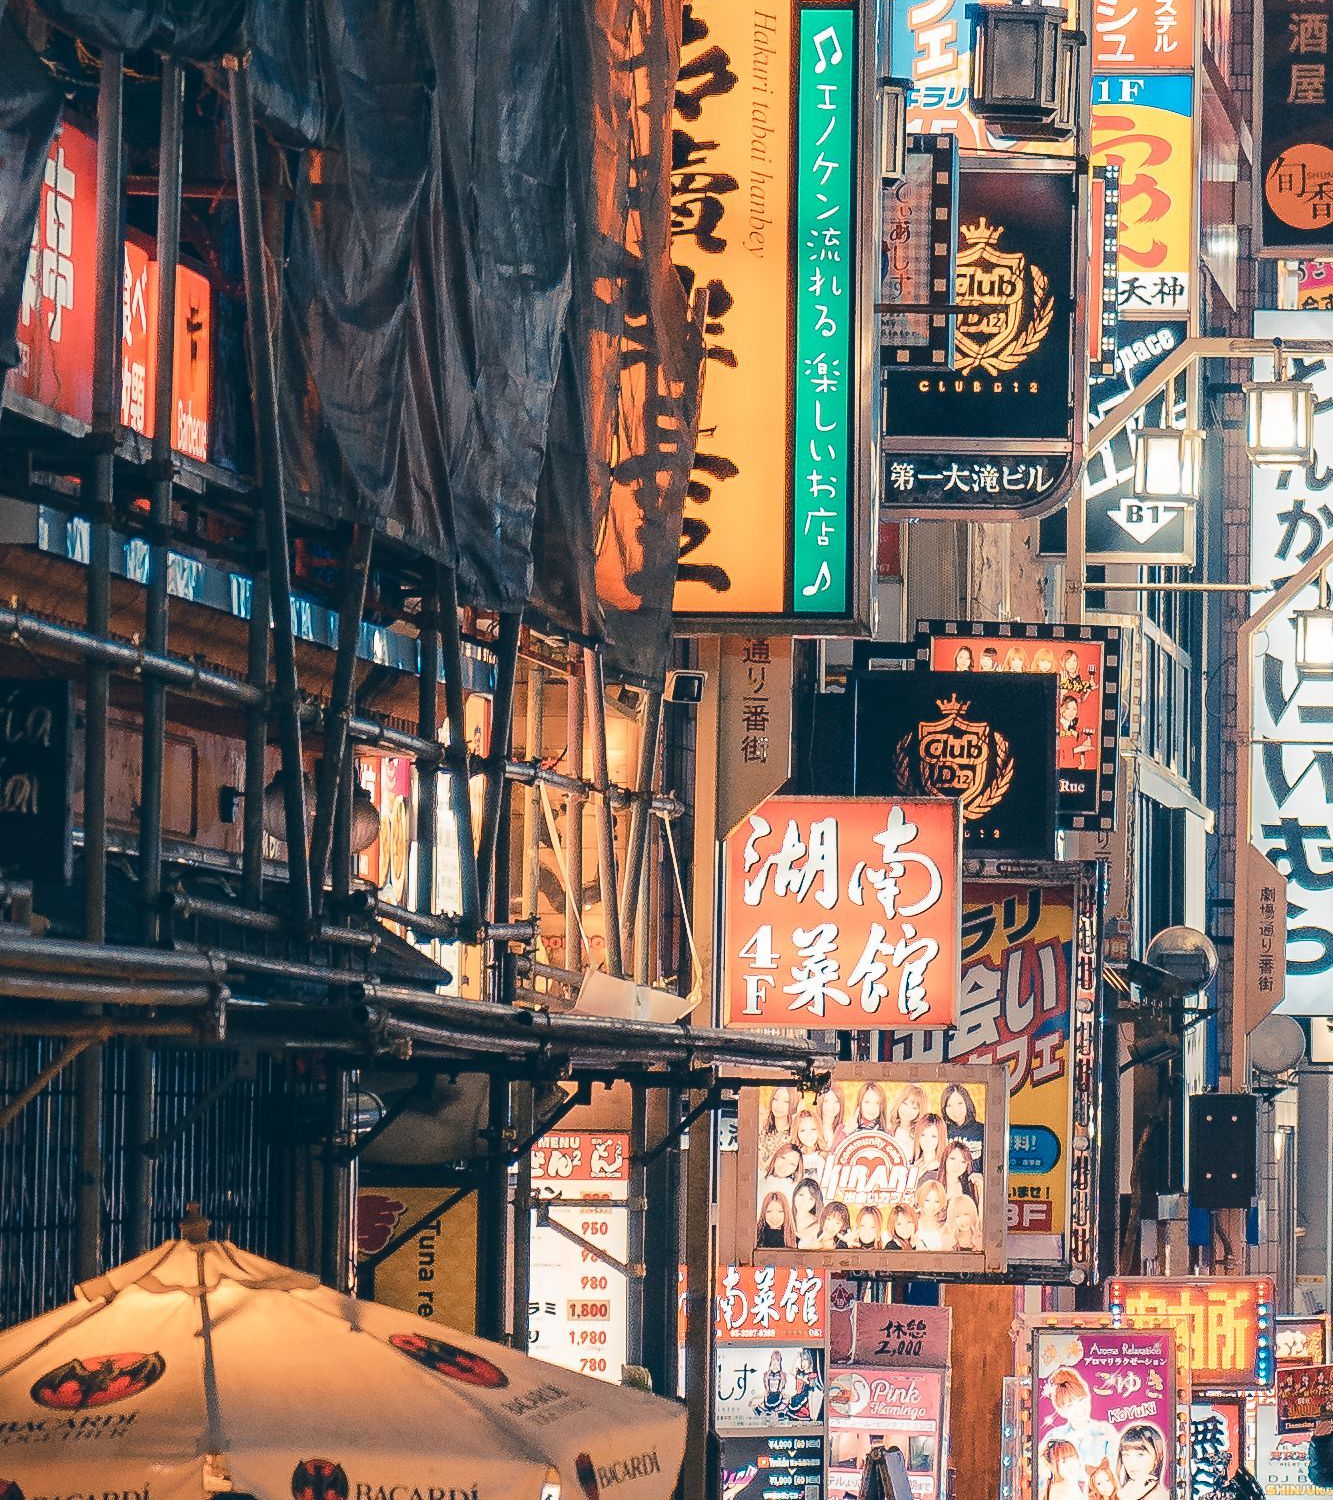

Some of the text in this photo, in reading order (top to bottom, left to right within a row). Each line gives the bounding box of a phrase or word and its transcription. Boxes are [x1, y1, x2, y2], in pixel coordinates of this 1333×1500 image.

[1097, 78, 1146, 102] 1F
[740, 9, 777, 260] Hakuri tabai hanbey
[803, 82, 842, 547] エノケン流れる 楽しいお店
[919, 380, 982, 394] CLUB
[889, 462, 1055, 494] 第一大滝ビル
[923, 735, 984, 762] Club
[744, 803, 944, 922] 湖南
[782, 921, 941, 1023] 菜館
[581, 1221, 608, 1236] 950
[569, 1303, 609, 1319] 1,800
[569, 1331, 608, 1347] 1,980
[877, 1336, 924, 1357] 2,000
[1089, 1342, 1163, 1357] Aroma Relaxation
[580, 1358, 608, 1371] 780
[873, 1377, 921, 1407] Pink
[1092, 1367, 1165, 1399] こゆき
[866, 1400, 927, 1419] Flamingo
